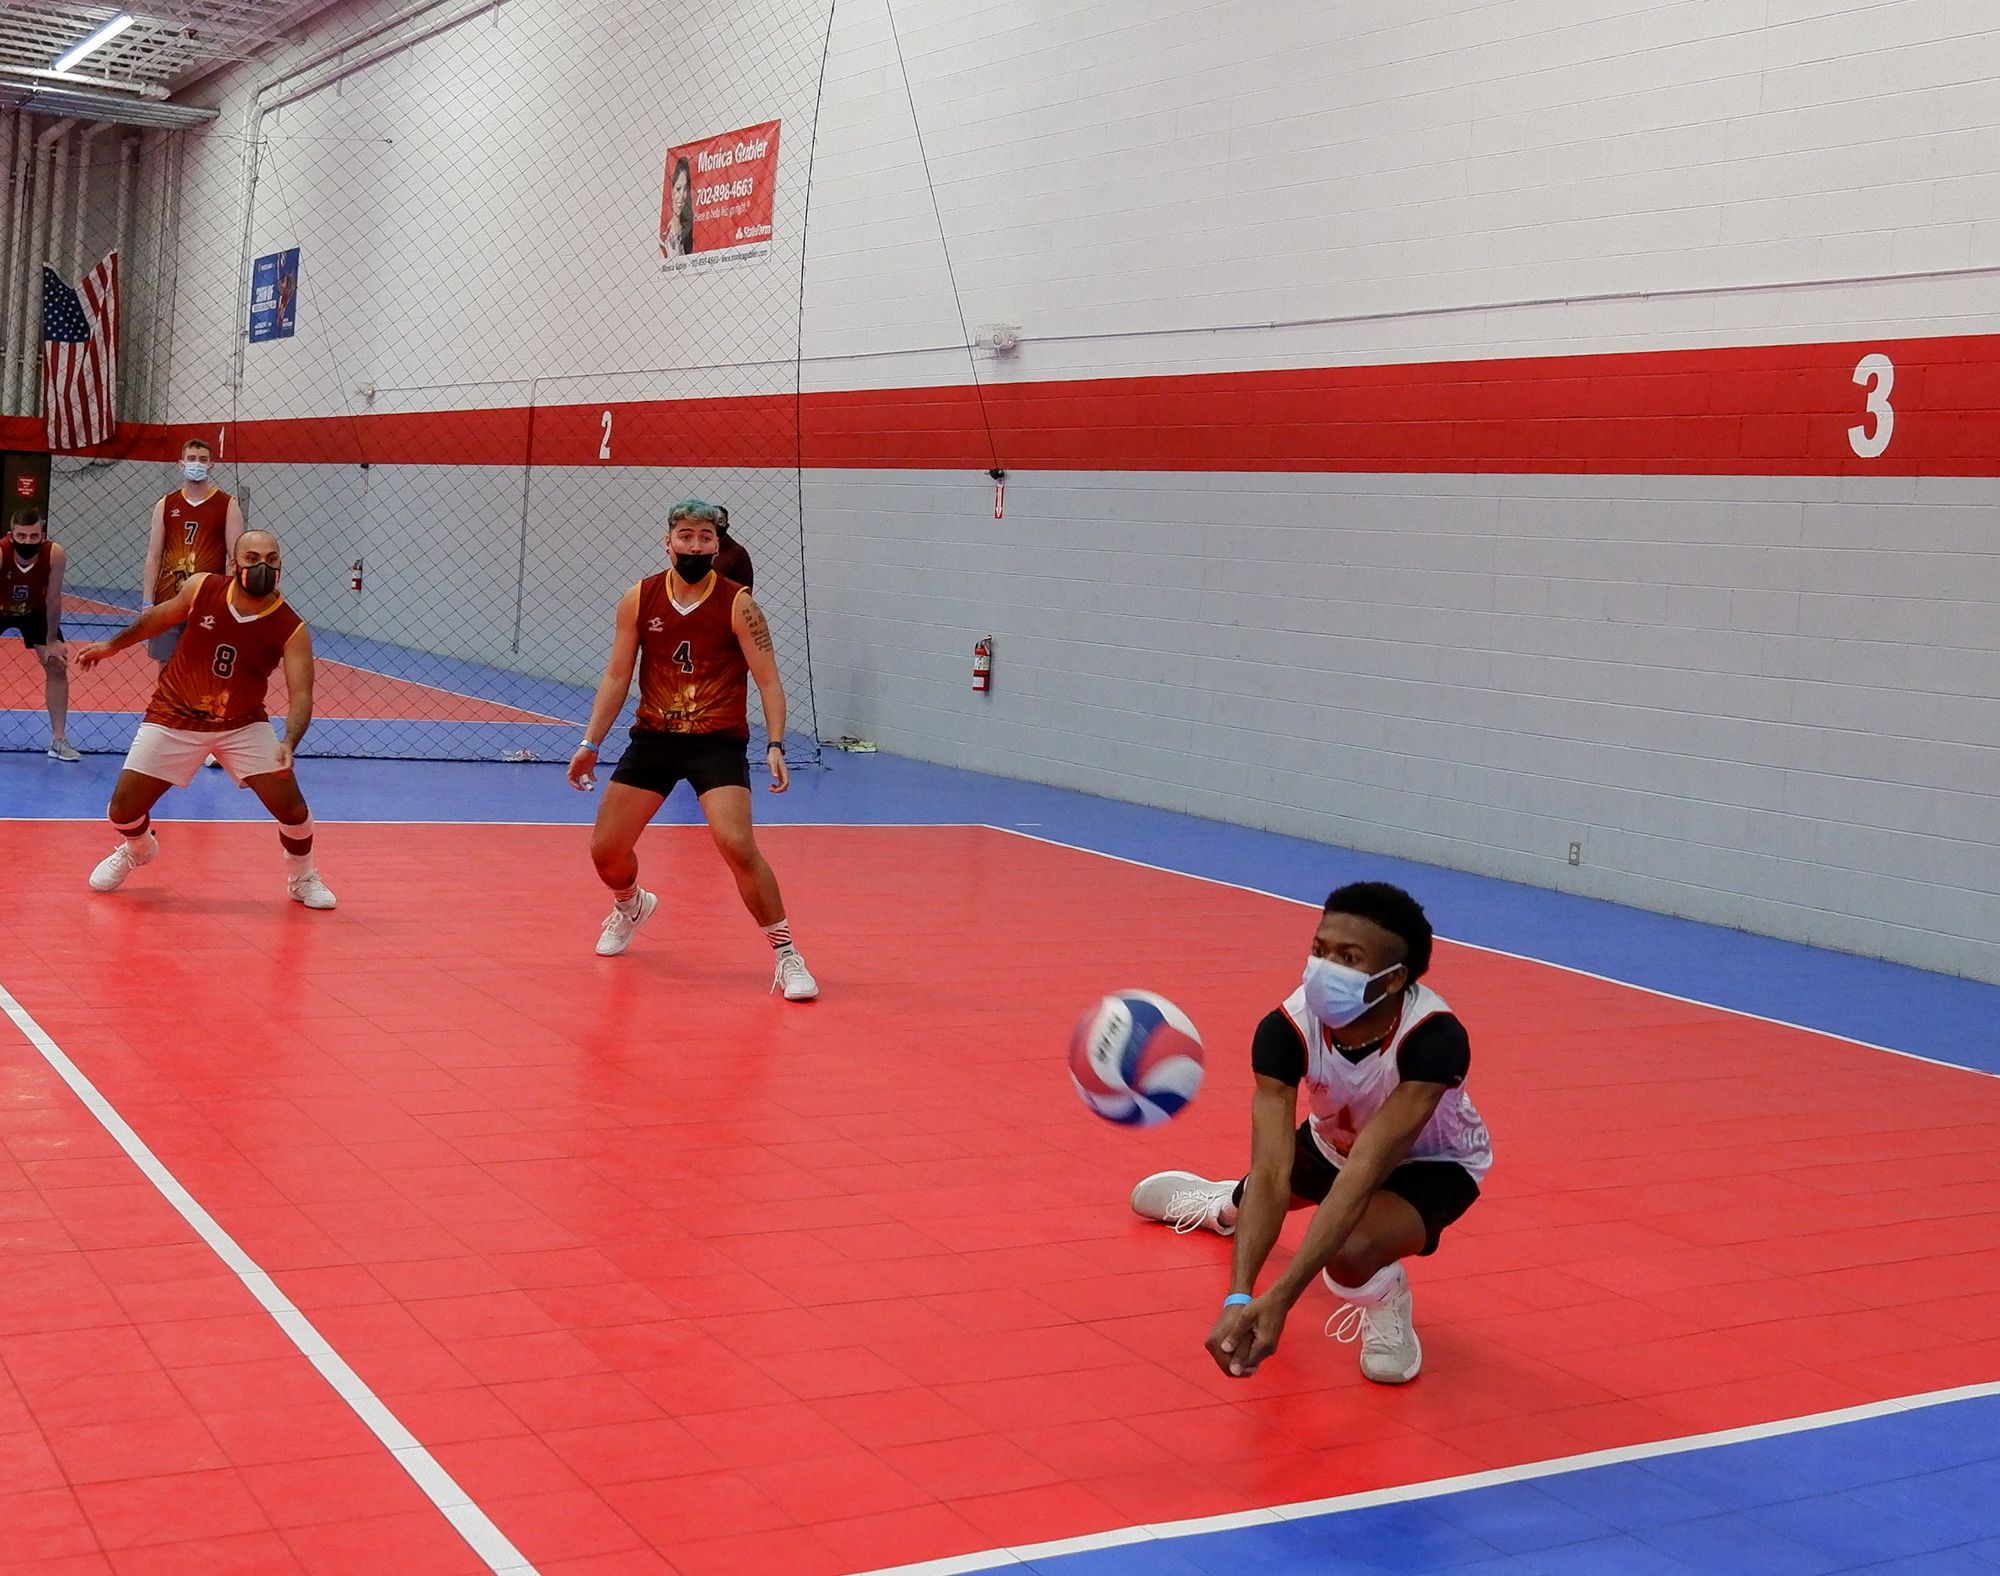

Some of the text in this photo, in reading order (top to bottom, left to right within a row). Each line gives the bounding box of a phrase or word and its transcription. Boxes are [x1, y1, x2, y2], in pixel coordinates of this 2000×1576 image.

[698, 138, 768, 173] Monica Gubler
[695, 177, 753, 206] 702-898-4663
[1847, 353, 1894, 458] 3
[218, 426, 225, 459] 1
[599, 410, 612, 459] 2
[184, 521, 199, 544] 7
[12, 585, 29, 601] 5
[212, 644, 237, 678] 8
[672, 640, 694, 674] 4
